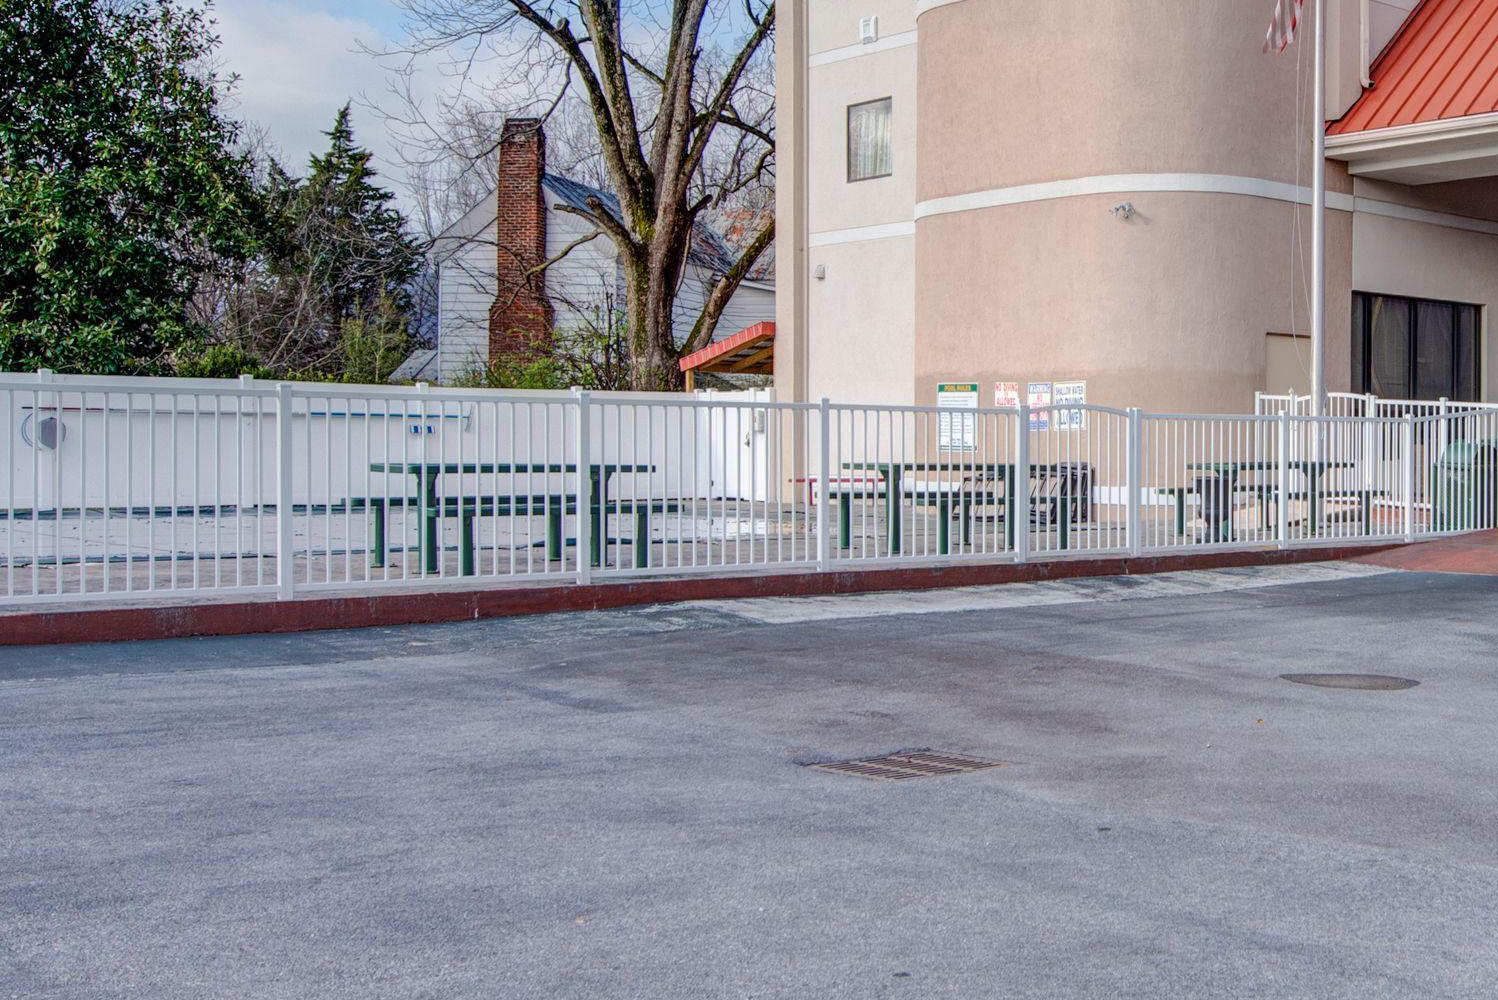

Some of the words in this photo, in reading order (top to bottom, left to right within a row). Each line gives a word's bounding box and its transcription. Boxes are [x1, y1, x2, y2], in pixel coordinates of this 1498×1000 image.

[944, 384, 956, 392] POOL
[995, 383, 1002, 391] NO
[1003, 383, 1018, 391] DIVING
[1056, 386, 1071, 395] SHALLOW
[1072, 385, 1083, 395] WATER
[997, 397, 1016, 405] ALLOWED
